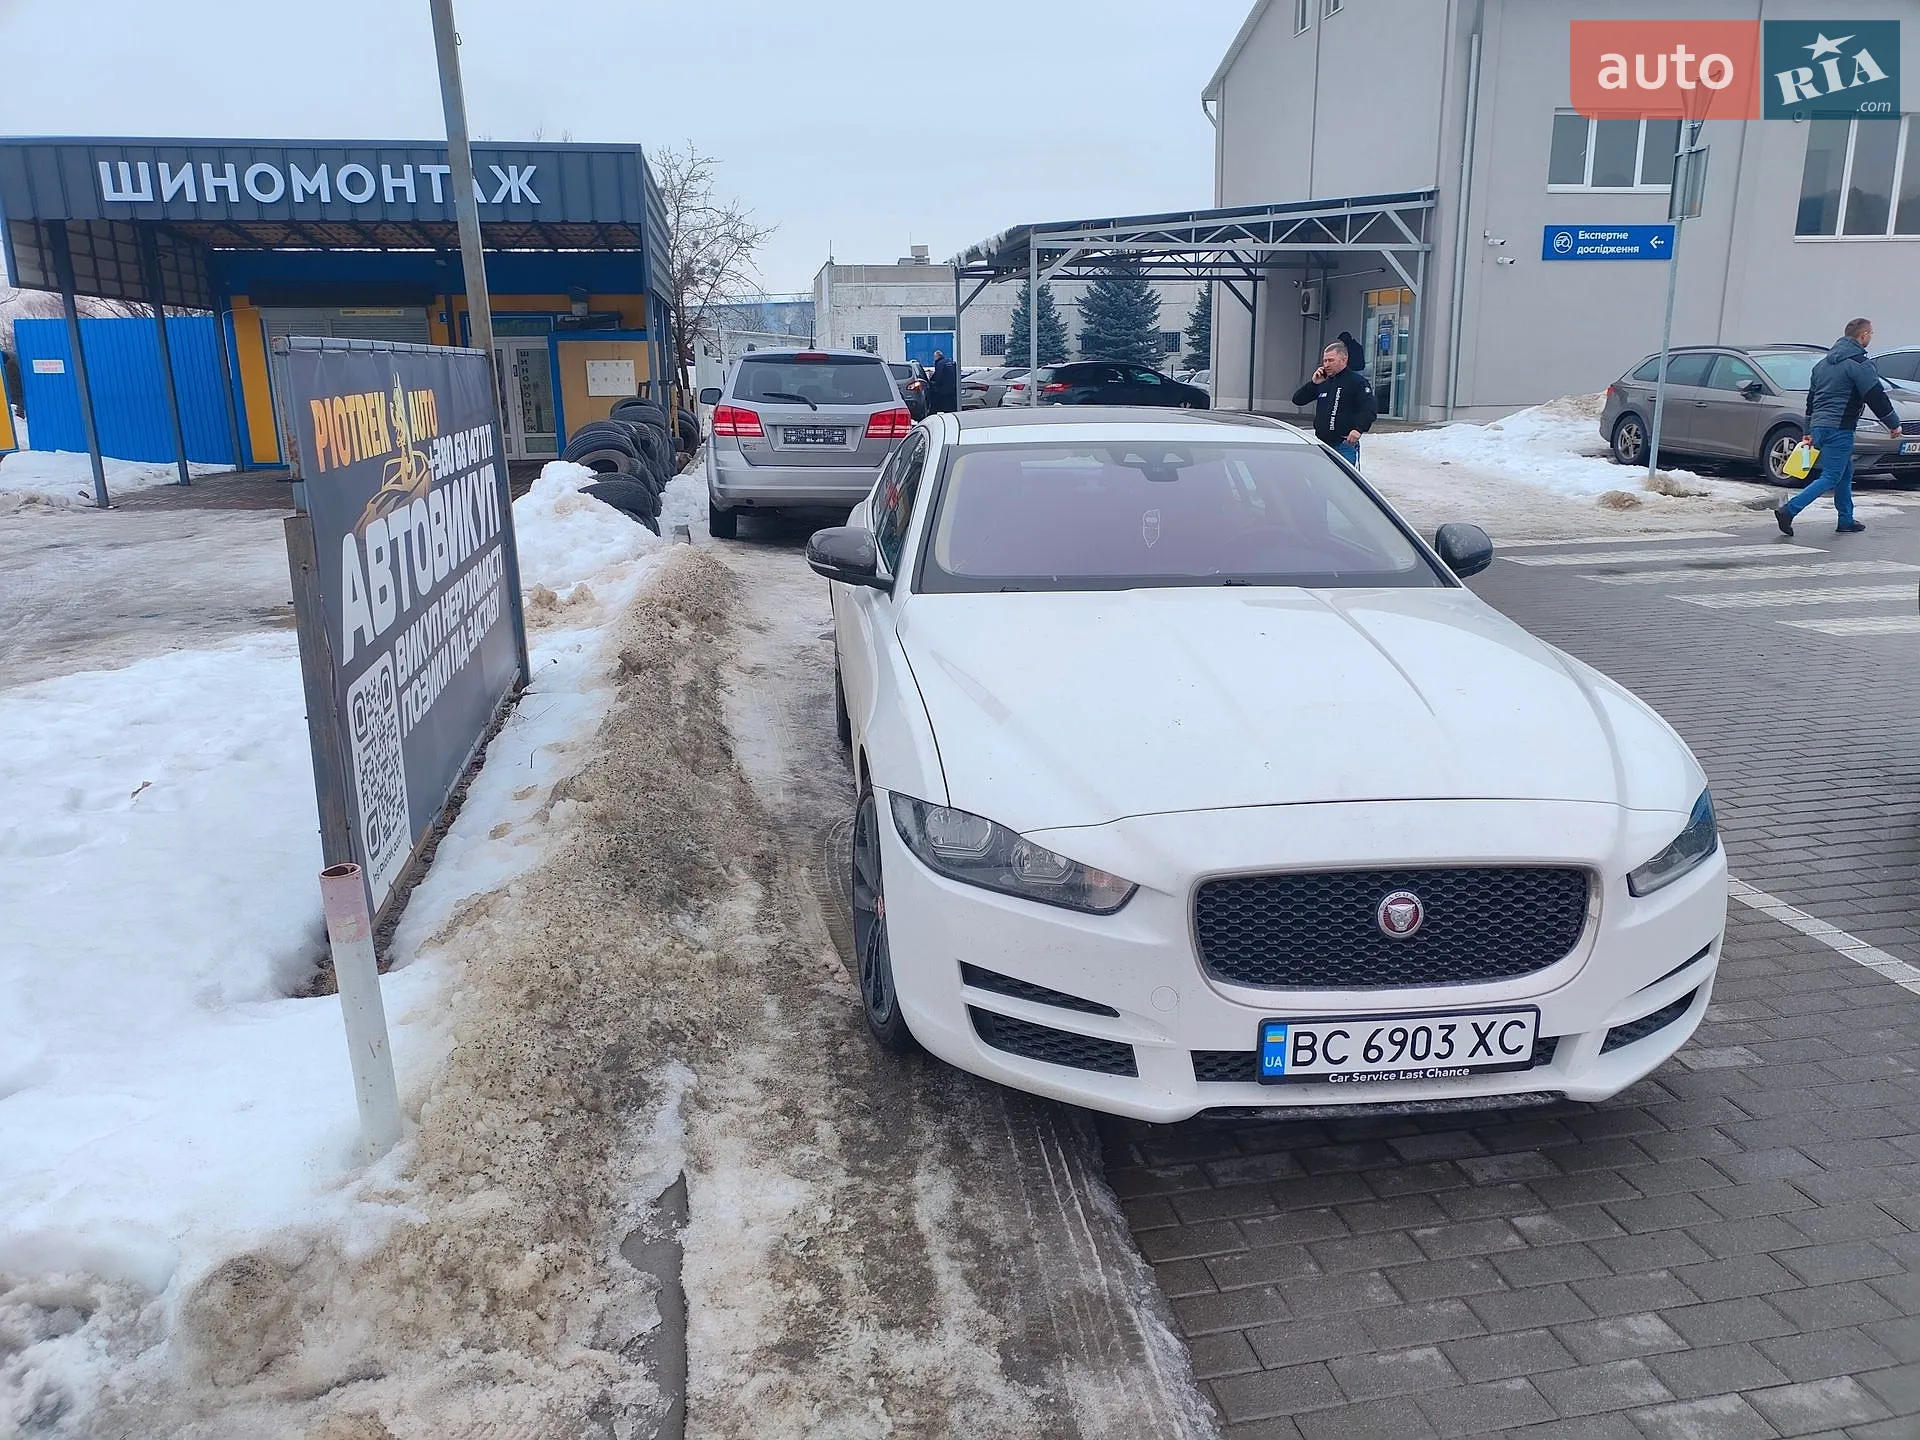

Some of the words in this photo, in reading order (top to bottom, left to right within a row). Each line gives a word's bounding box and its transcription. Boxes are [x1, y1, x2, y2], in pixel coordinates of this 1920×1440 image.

[1576, 244, 1640, 255] дослідження
[1578, 230, 1629, 242] Експертне
[310, 391, 393, 473] PIOTREK
[407, 388, 439, 443] AUTO
[428, 435, 455, 482] +380
[342, 464, 500, 667] АВТОВИКУП
[395, 600, 443, 688] ВИКУП
[441, 543, 504, 638] НЕРУХОМОСТІ
[401, 642, 452, 739] ПОЗИКИ
[449, 624, 471, 672] ПІД
[467, 585, 501, 653] ЗАСТАВУ
[1264, 1055, 1283, 1068] UA
[1291, 1029, 1350, 1067] BC
[1362, 1023, 1457, 1064] 6903
[1467, 1019, 1527, 1058] XC
[1328, 1072, 1351, 1084] Car
[1351, 1069, 1397, 1083] Service
[1399, 1067, 1424, 1081] Last
[1426, 1066, 1470, 1079] Chance
